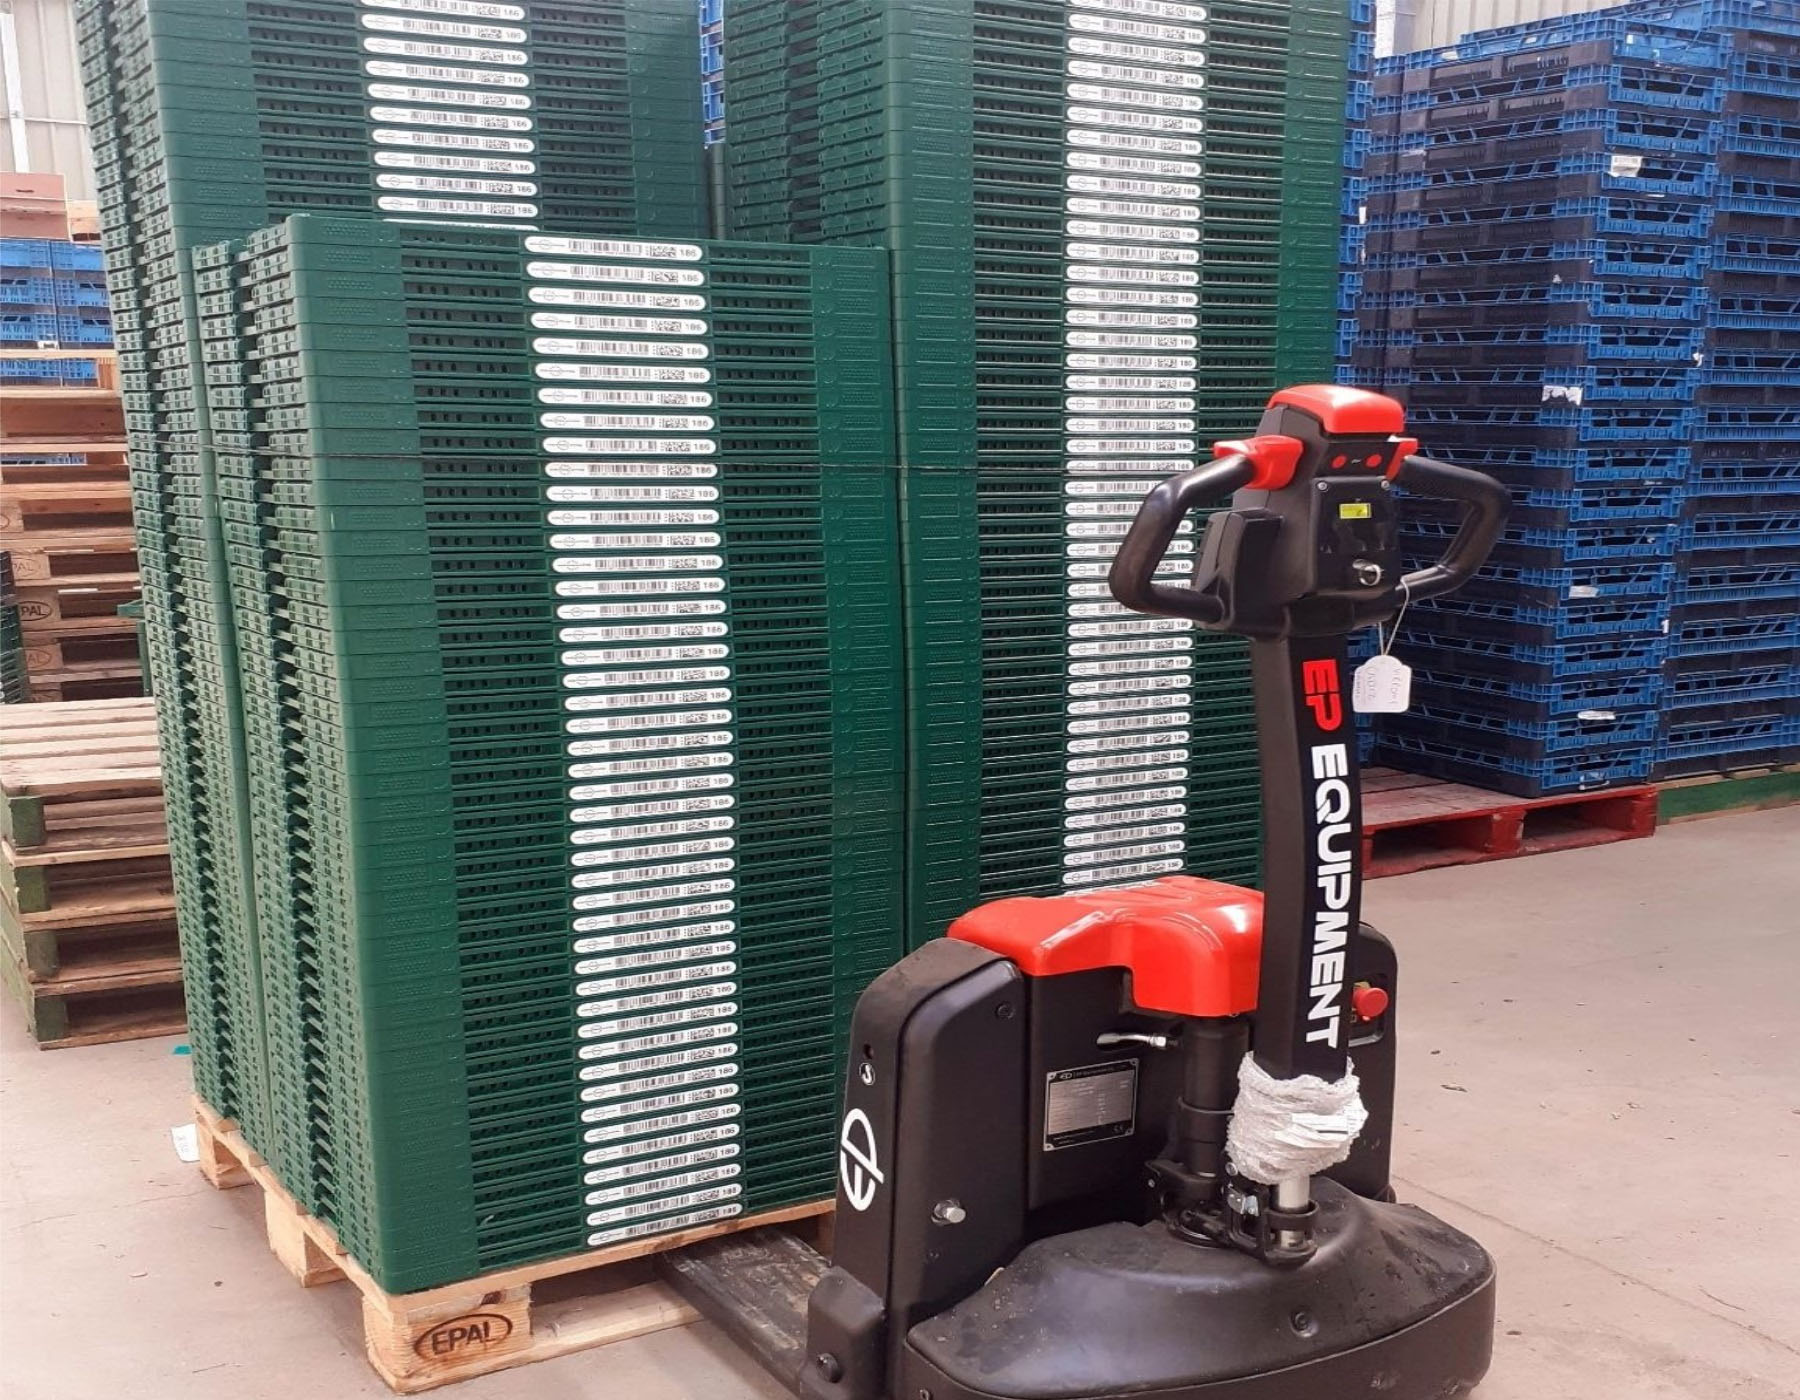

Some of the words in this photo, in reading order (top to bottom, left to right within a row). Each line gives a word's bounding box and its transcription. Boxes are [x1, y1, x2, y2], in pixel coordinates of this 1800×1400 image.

[21, 605, 48, 616] PAL
[1303, 659, 1343, 732] EP
[1306, 743, 1352, 1049] EQUIPMENT
[432, 1320, 496, 1356] EPAL
